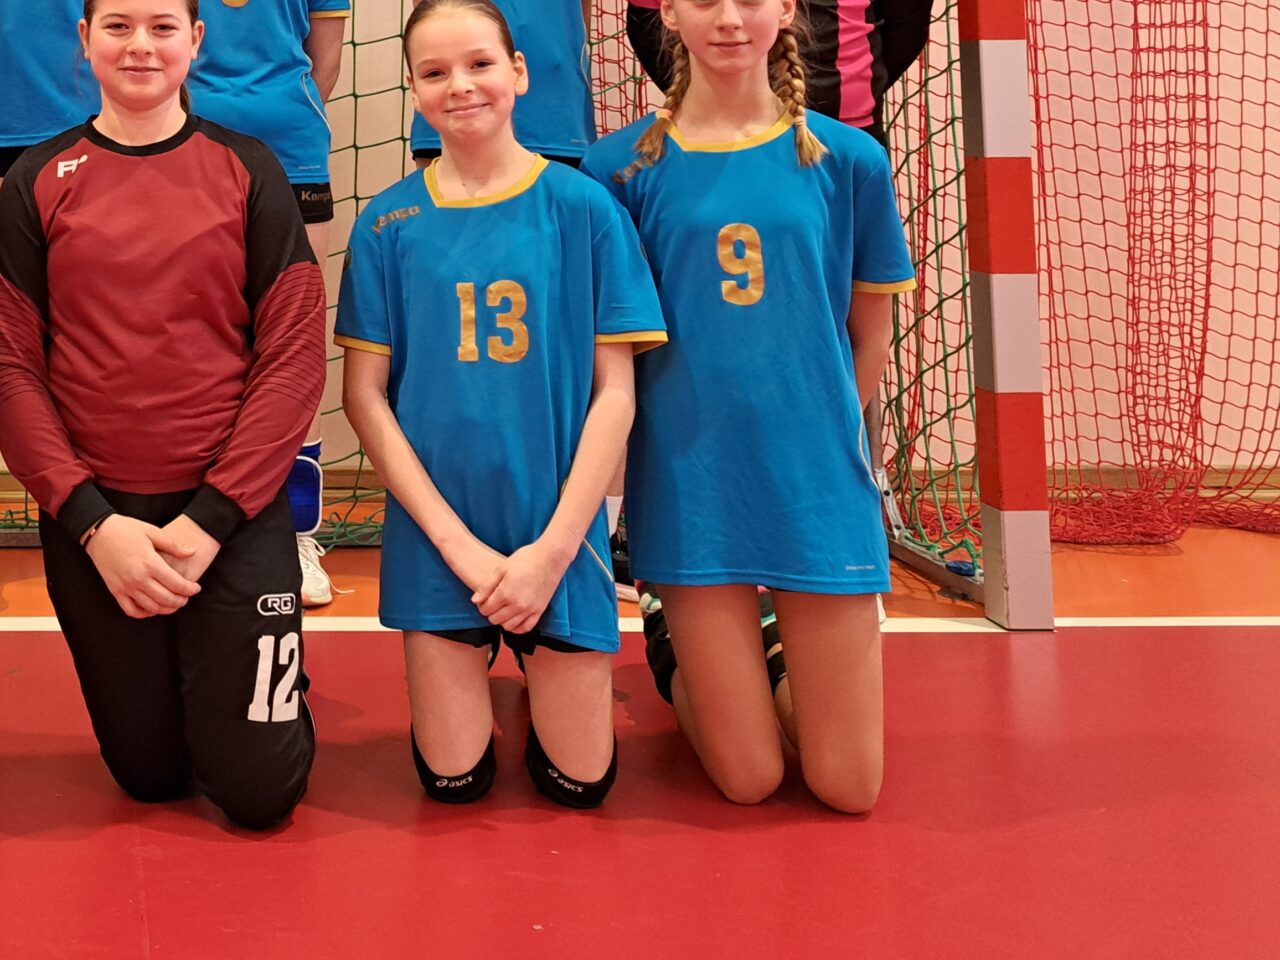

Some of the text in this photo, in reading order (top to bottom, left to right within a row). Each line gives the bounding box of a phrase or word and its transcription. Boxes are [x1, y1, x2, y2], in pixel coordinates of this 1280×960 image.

[716, 222, 765, 306] 9
[456, 279, 530, 364] 13
[247, 631, 300, 722] 12
